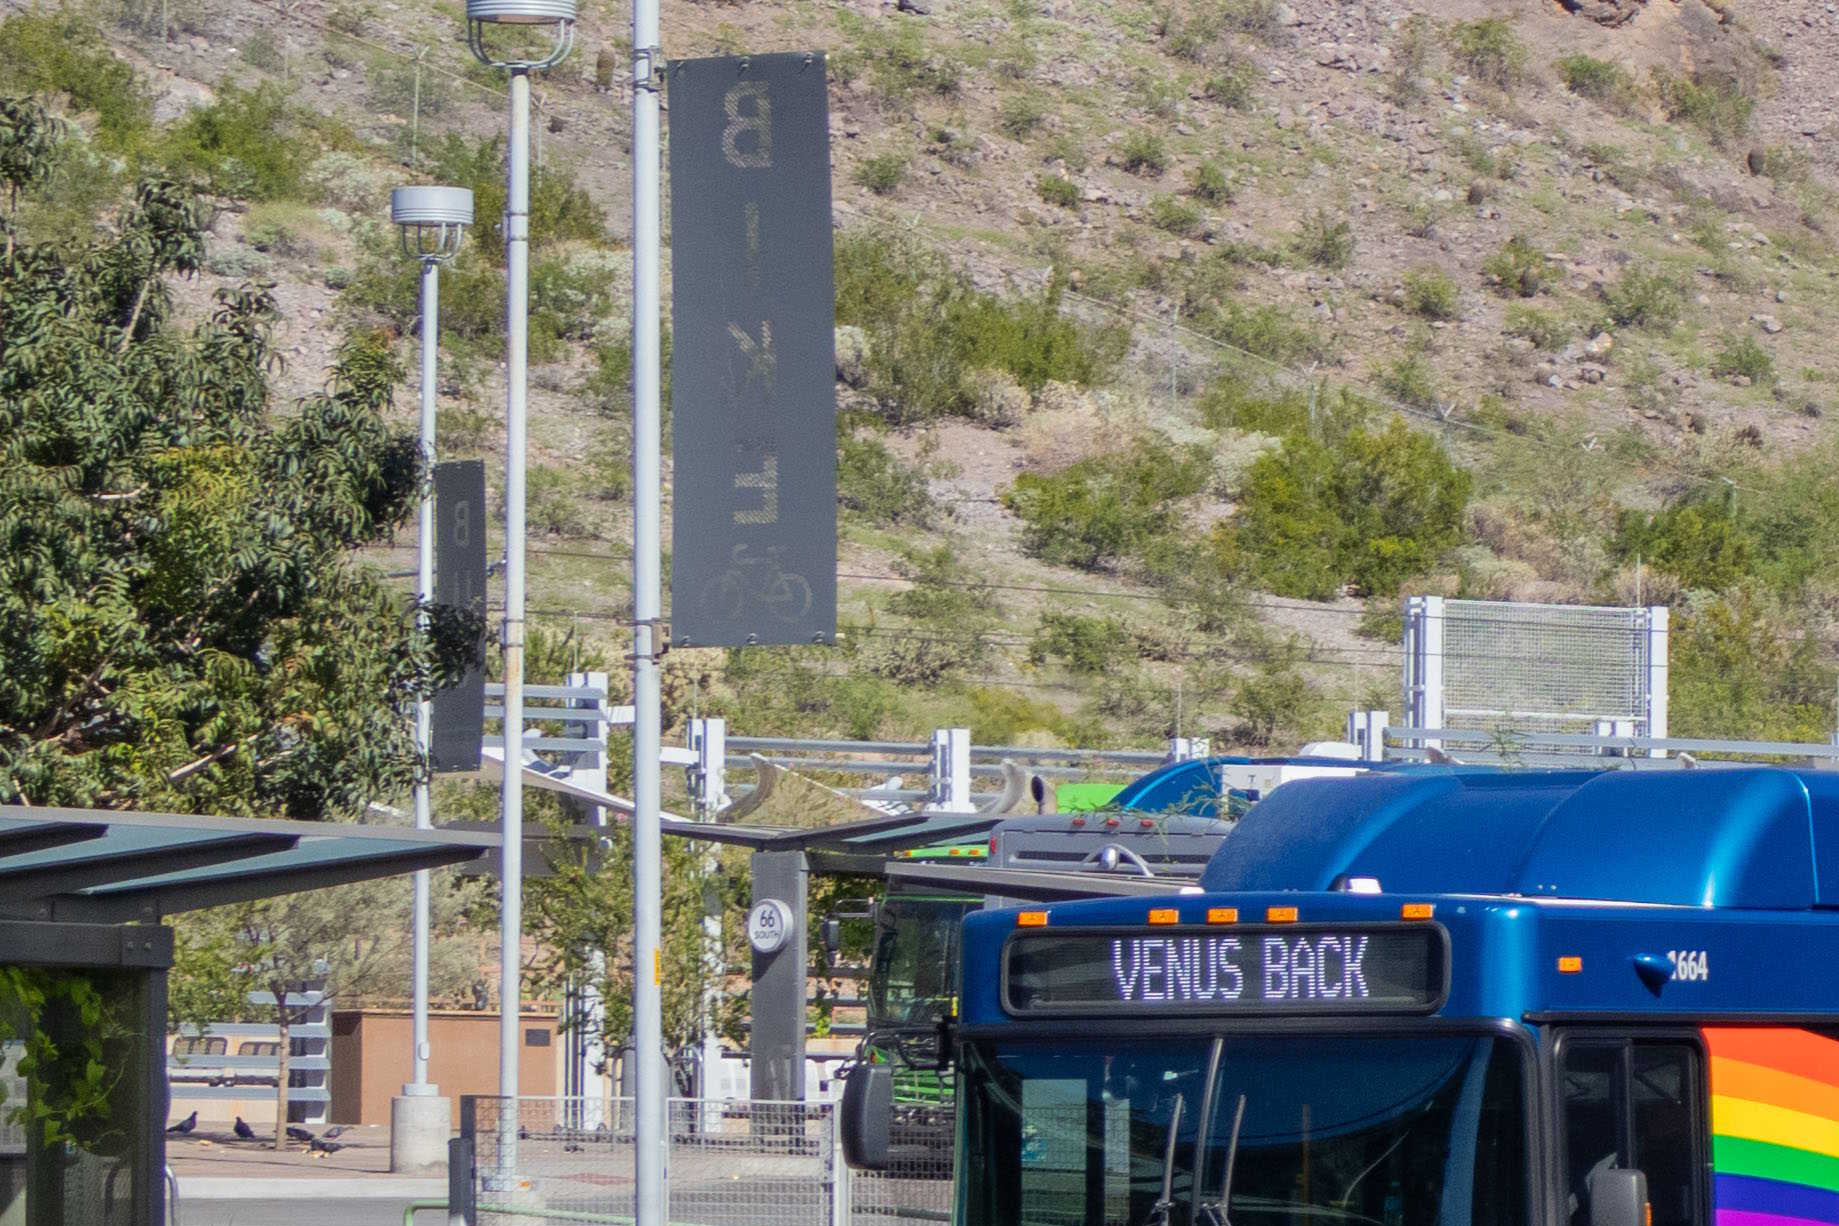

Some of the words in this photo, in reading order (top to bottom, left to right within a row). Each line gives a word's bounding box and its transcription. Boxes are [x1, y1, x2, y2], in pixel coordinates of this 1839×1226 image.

[760, 909, 776, 928] 66
[1111, 937, 1244, 1000] VENUS
[1263, 935, 1370, 999] BACK
